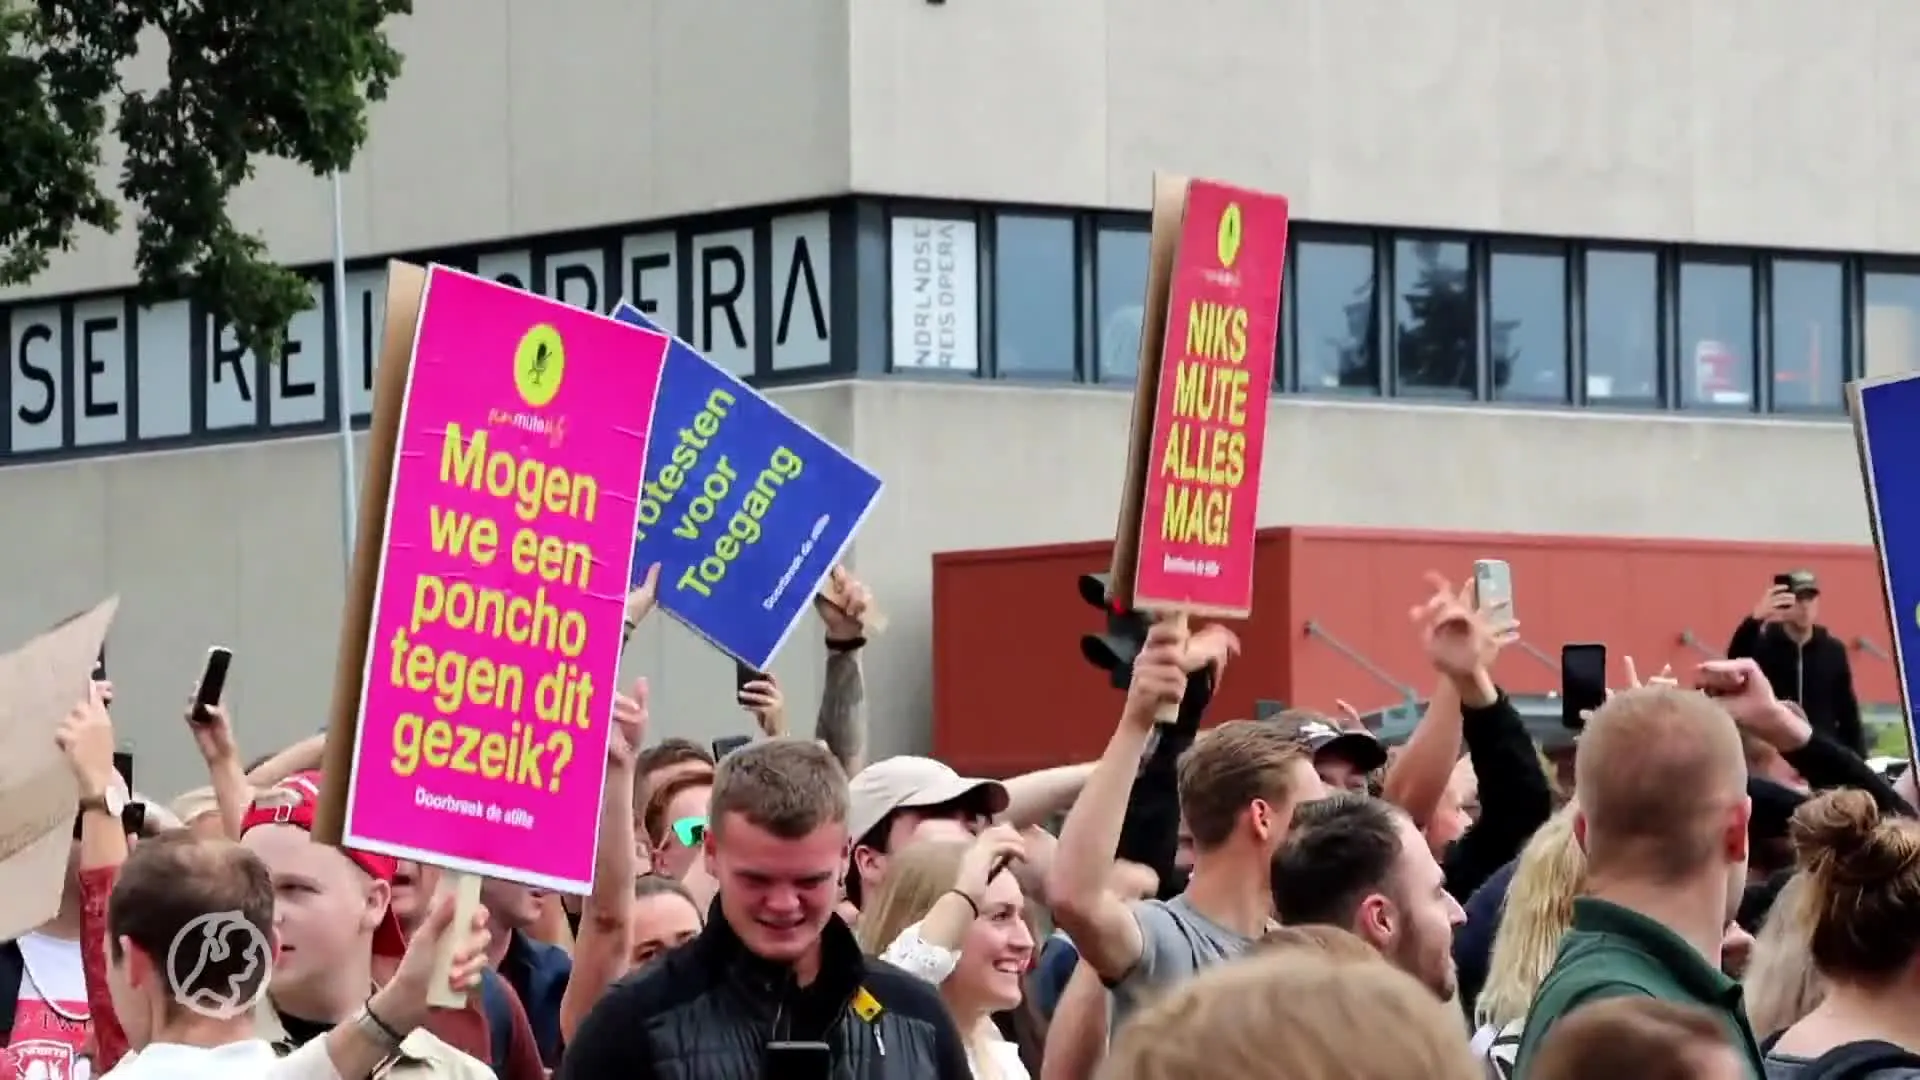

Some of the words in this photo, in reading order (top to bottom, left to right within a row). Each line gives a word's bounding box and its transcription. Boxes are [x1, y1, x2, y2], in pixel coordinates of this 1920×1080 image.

[1186, 298, 1248, 364] NIKS
[1172, 359, 1249, 427] MUTE
[440, 421, 597, 522] Mogen
[638, 387, 736, 541] otesten
[672, 454, 738, 541] voor
[1161, 421, 1246, 488] ALLES
[430, 504, 499, 567] we
[511, 527, 594, 591] een
[676, 445, 804, 598] Toegang
[1161, 483, 1232, 547] MAG!
[411, 573, 588, 658] poncho
[390, 626, 524, 714] tegen
[534, 661, 595, 730] dit
[390, 712, 574, 793] gezeik?
